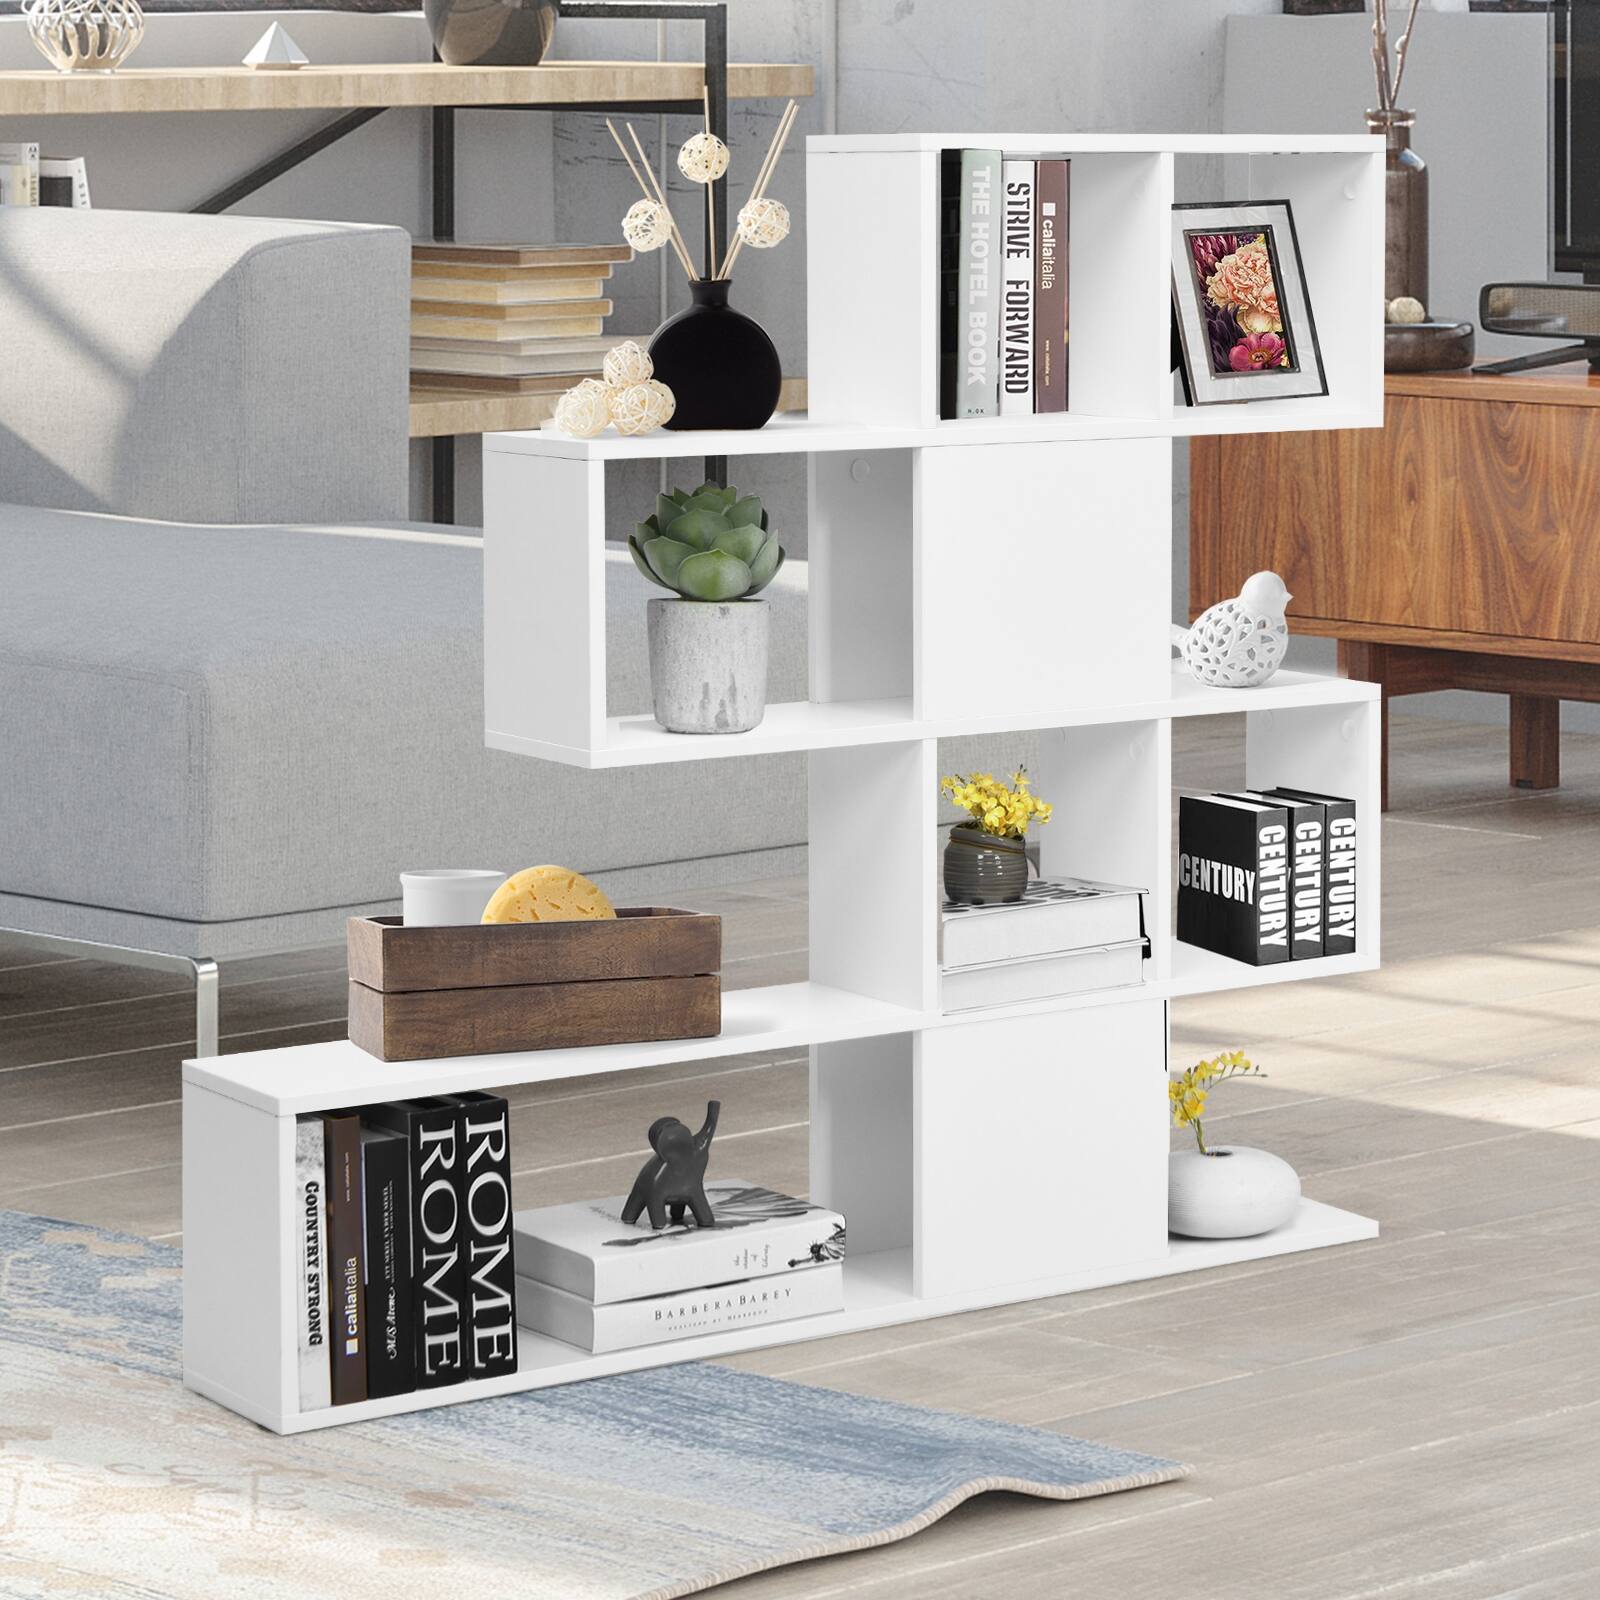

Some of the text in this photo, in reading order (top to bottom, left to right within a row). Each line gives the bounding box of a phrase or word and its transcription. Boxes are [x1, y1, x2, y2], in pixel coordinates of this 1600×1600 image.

[967, 165, 991, 386] THE HOTEL BOOK
[1004, 183, 1031, 394] STRIVE FORWARD
[1041, 219, 1056, 290] caliaitalia
[1179, 853, 1256, 905] CENTURY
[1259, 825, 1287, 946] CENTURY
[1294, 821, 1323, 943] CENTURY
[1329, 818, 1356, 938] CENTURY
[304, 1181, 324, 1347] COUNTRY STRONG
[344, 1256, 359, 1336] caliaitalia
[419, 1119, 461, 1375] ROME
[465, 1111, 514, 1368] ROME
[654, 1299, 733, 1321] BARBERA
[739, 1288, 792, 1306] BAREY
